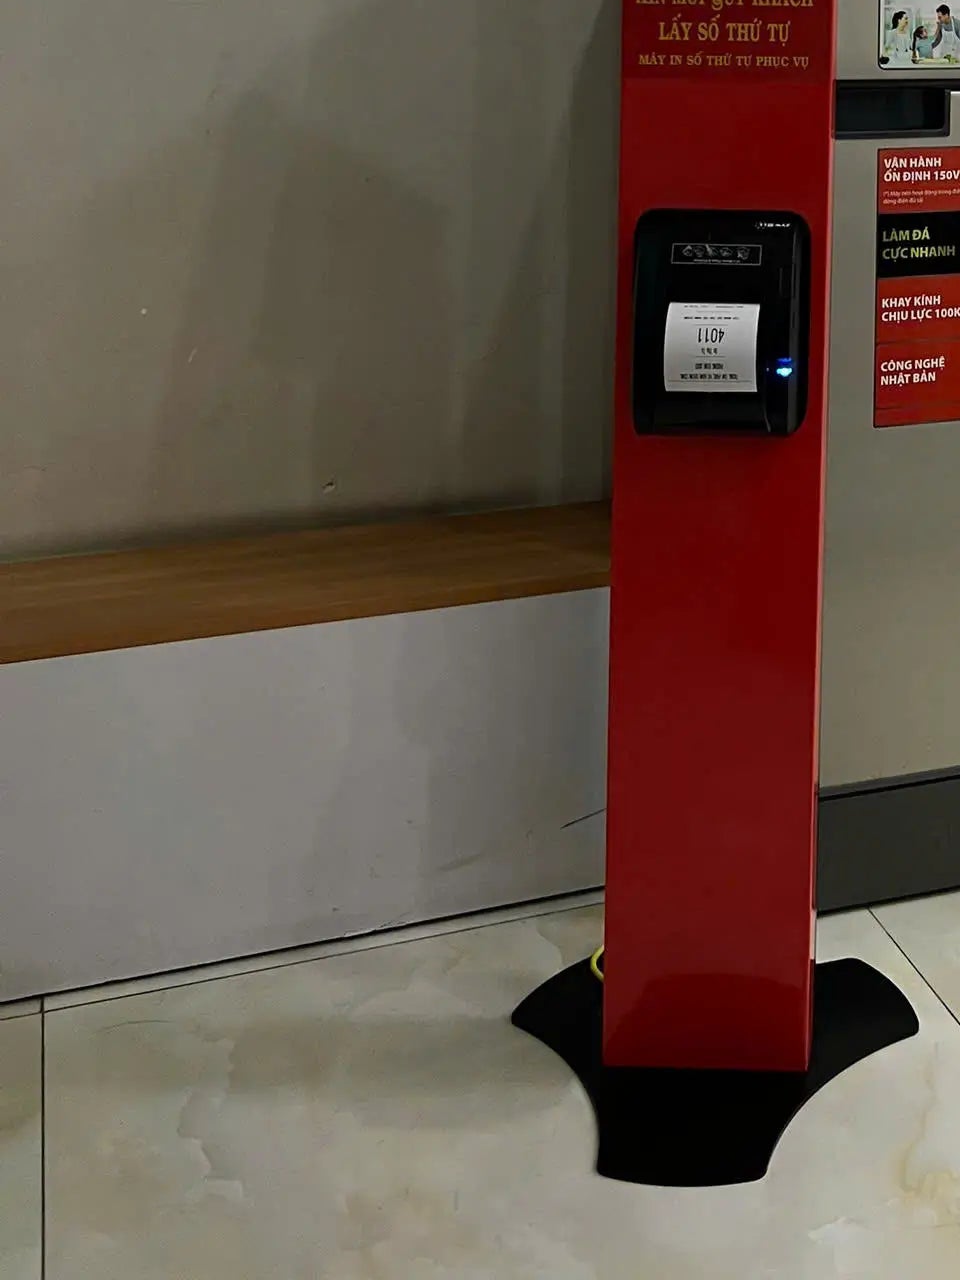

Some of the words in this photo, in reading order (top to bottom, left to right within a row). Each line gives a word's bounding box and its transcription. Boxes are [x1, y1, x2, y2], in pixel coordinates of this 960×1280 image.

[658, 13, 693, 41] LẤY
[697, 14, 721, 42] SỐ
[726, 17, 762, 42] THỨ
[767, 20, 791, 47] TỰ
[638, 52, 666, 66] MÁY
[669, 54, 682, 66] IN
[686, 51, 703, 66] SỐ
[706, 52, 732, 67] THỨ
[793, 56, 809, 70] VỤ
[884, 157, 907, 170] VẬN
[910, 156, 942, 168] HÀNH
[903, 171, 931, 184] ĐỊNH
[934, 170, 960, 180] 150V
[883, 228, 910, 242] LÀM
[912, 226, 930, 241] ĐÁ
[882, 246, 909, 263] CỰC
[911, 245, 956, 259] NHANH
[882, 296, 911, 308] KHAY
[914, 294, 941, 306] KÍNH
[882, 310, 909, 323] CHỊU
[911, 308, 932, 323] LỰC
[698, 327, 725, 344] 4011
[881, 357, 913, 372] CÔNG
[914, 356, 945, 371] NGHỆ
[881, 373, 911, 387] NHẬT
[913, 370, 936, 383] BẢN
